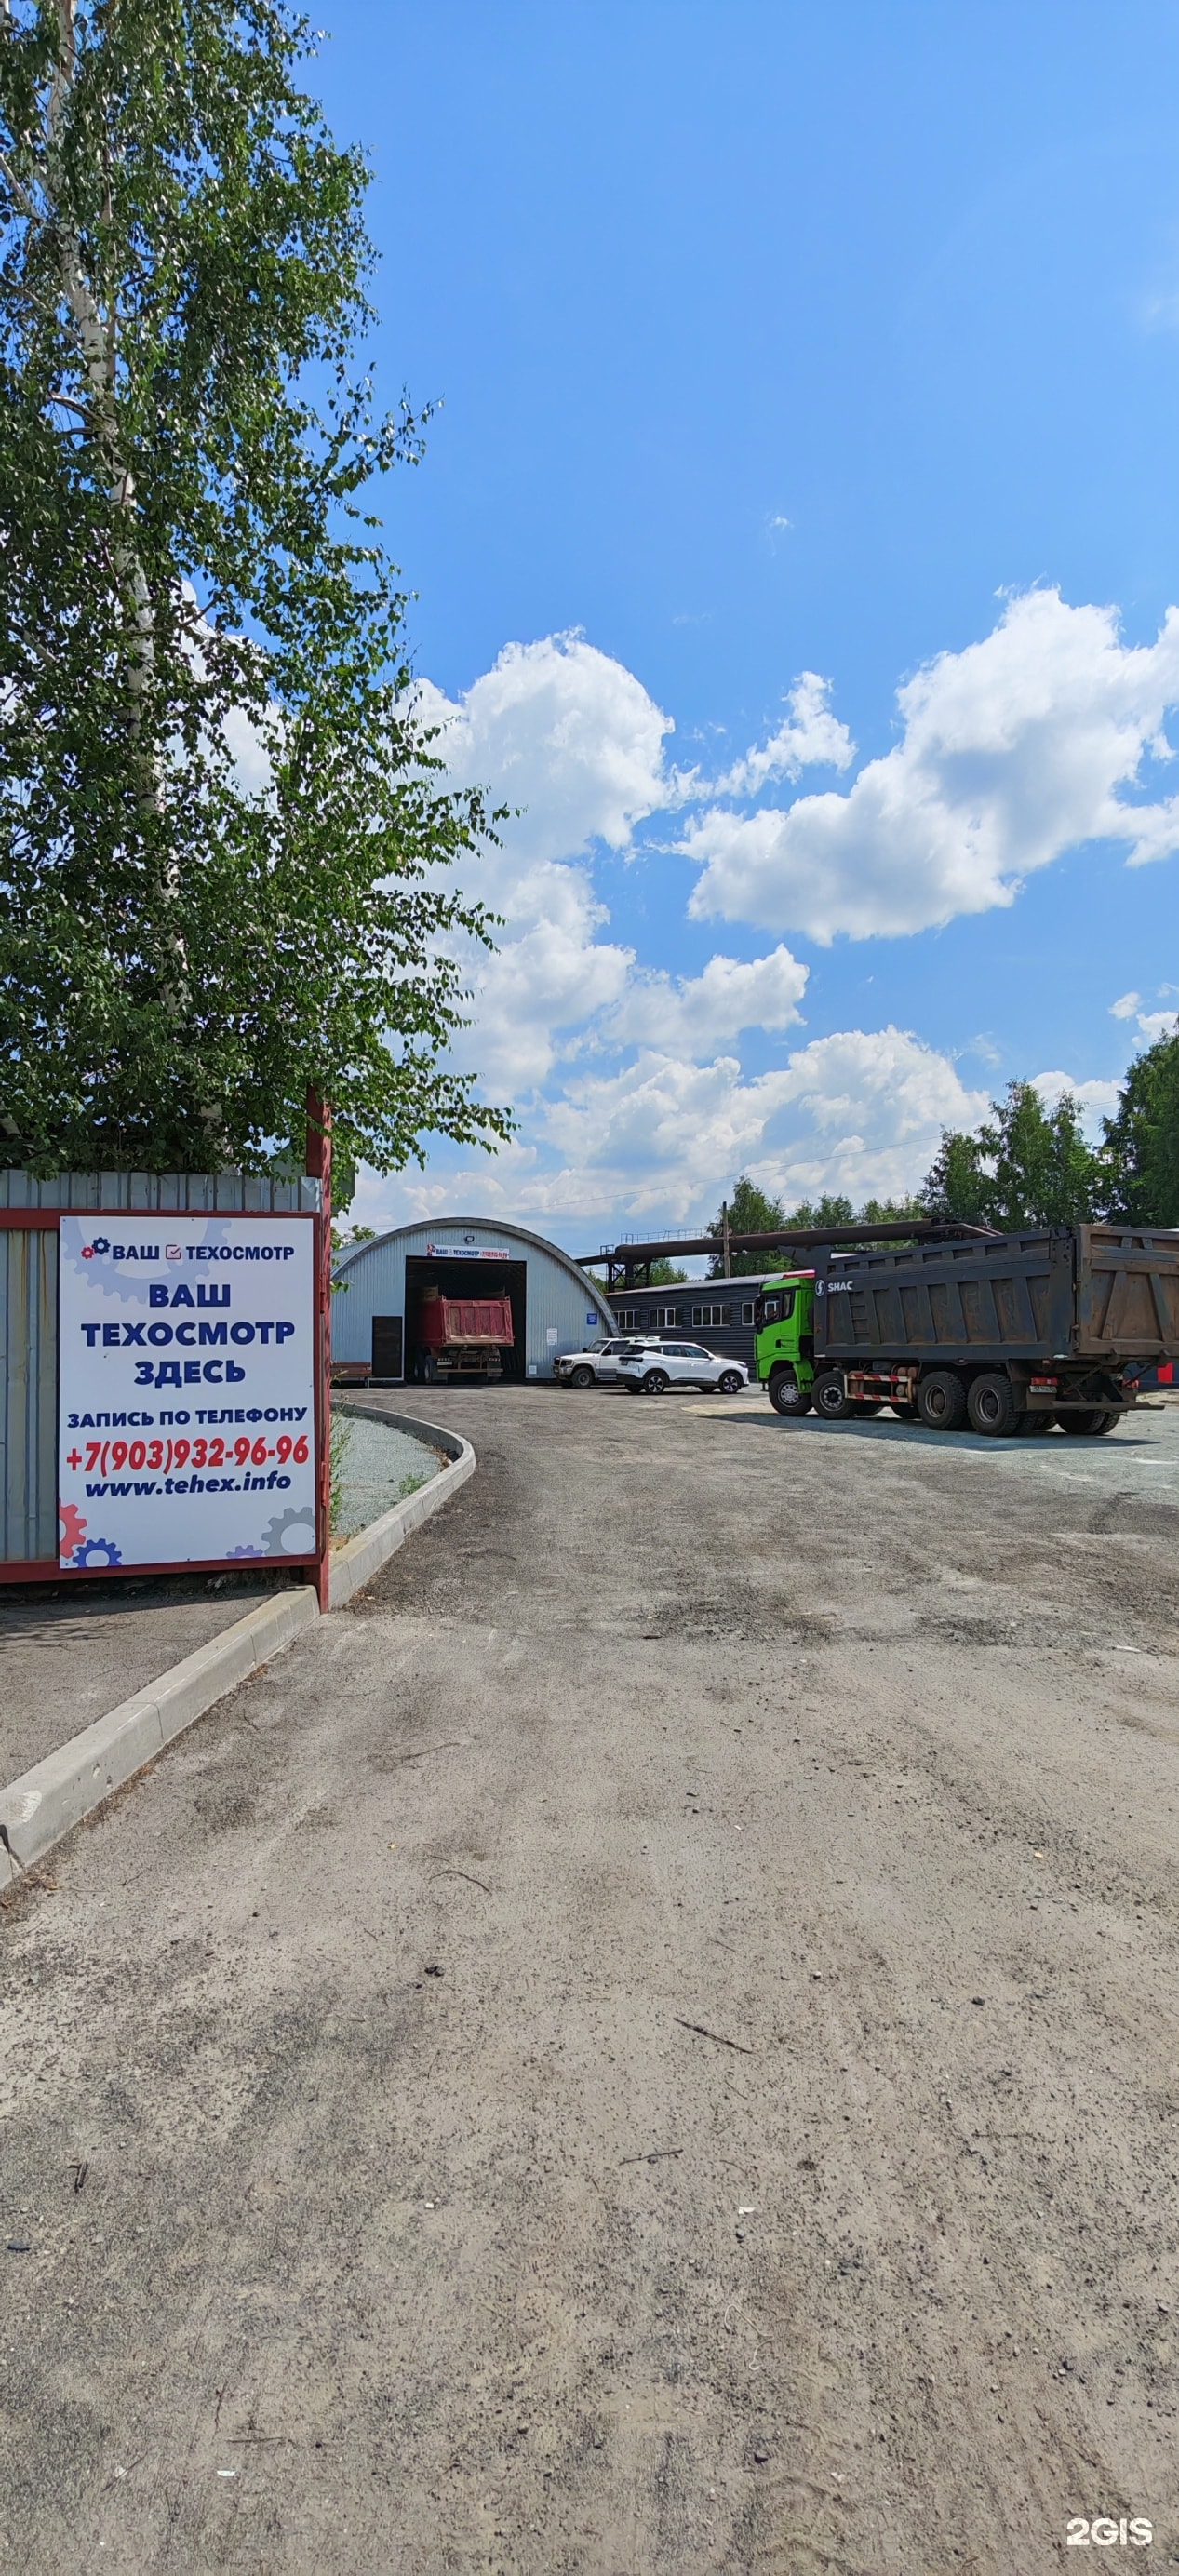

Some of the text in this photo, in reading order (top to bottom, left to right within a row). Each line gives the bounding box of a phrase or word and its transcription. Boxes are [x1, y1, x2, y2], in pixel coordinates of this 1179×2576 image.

[112, 1245, 295, 1260] ВАШ ТЕХОСМОТР
[149, 1284, 232, 1308] ВАШ
[827, 1281, 853, 1293] SHAC
[80, 1321, 296, 1348] ТЕХОСМОТР
[133, 1360, 246, 1389] ЗДЕСЬ
[67, 1407, 308, 1429] ЗАПИСЬ ПО ТЕЛЕФОНУ
[66, 1435, 309, 1478] +7(903)932-96-96
[85, 1471, 292, 1498] www.tehex.info
